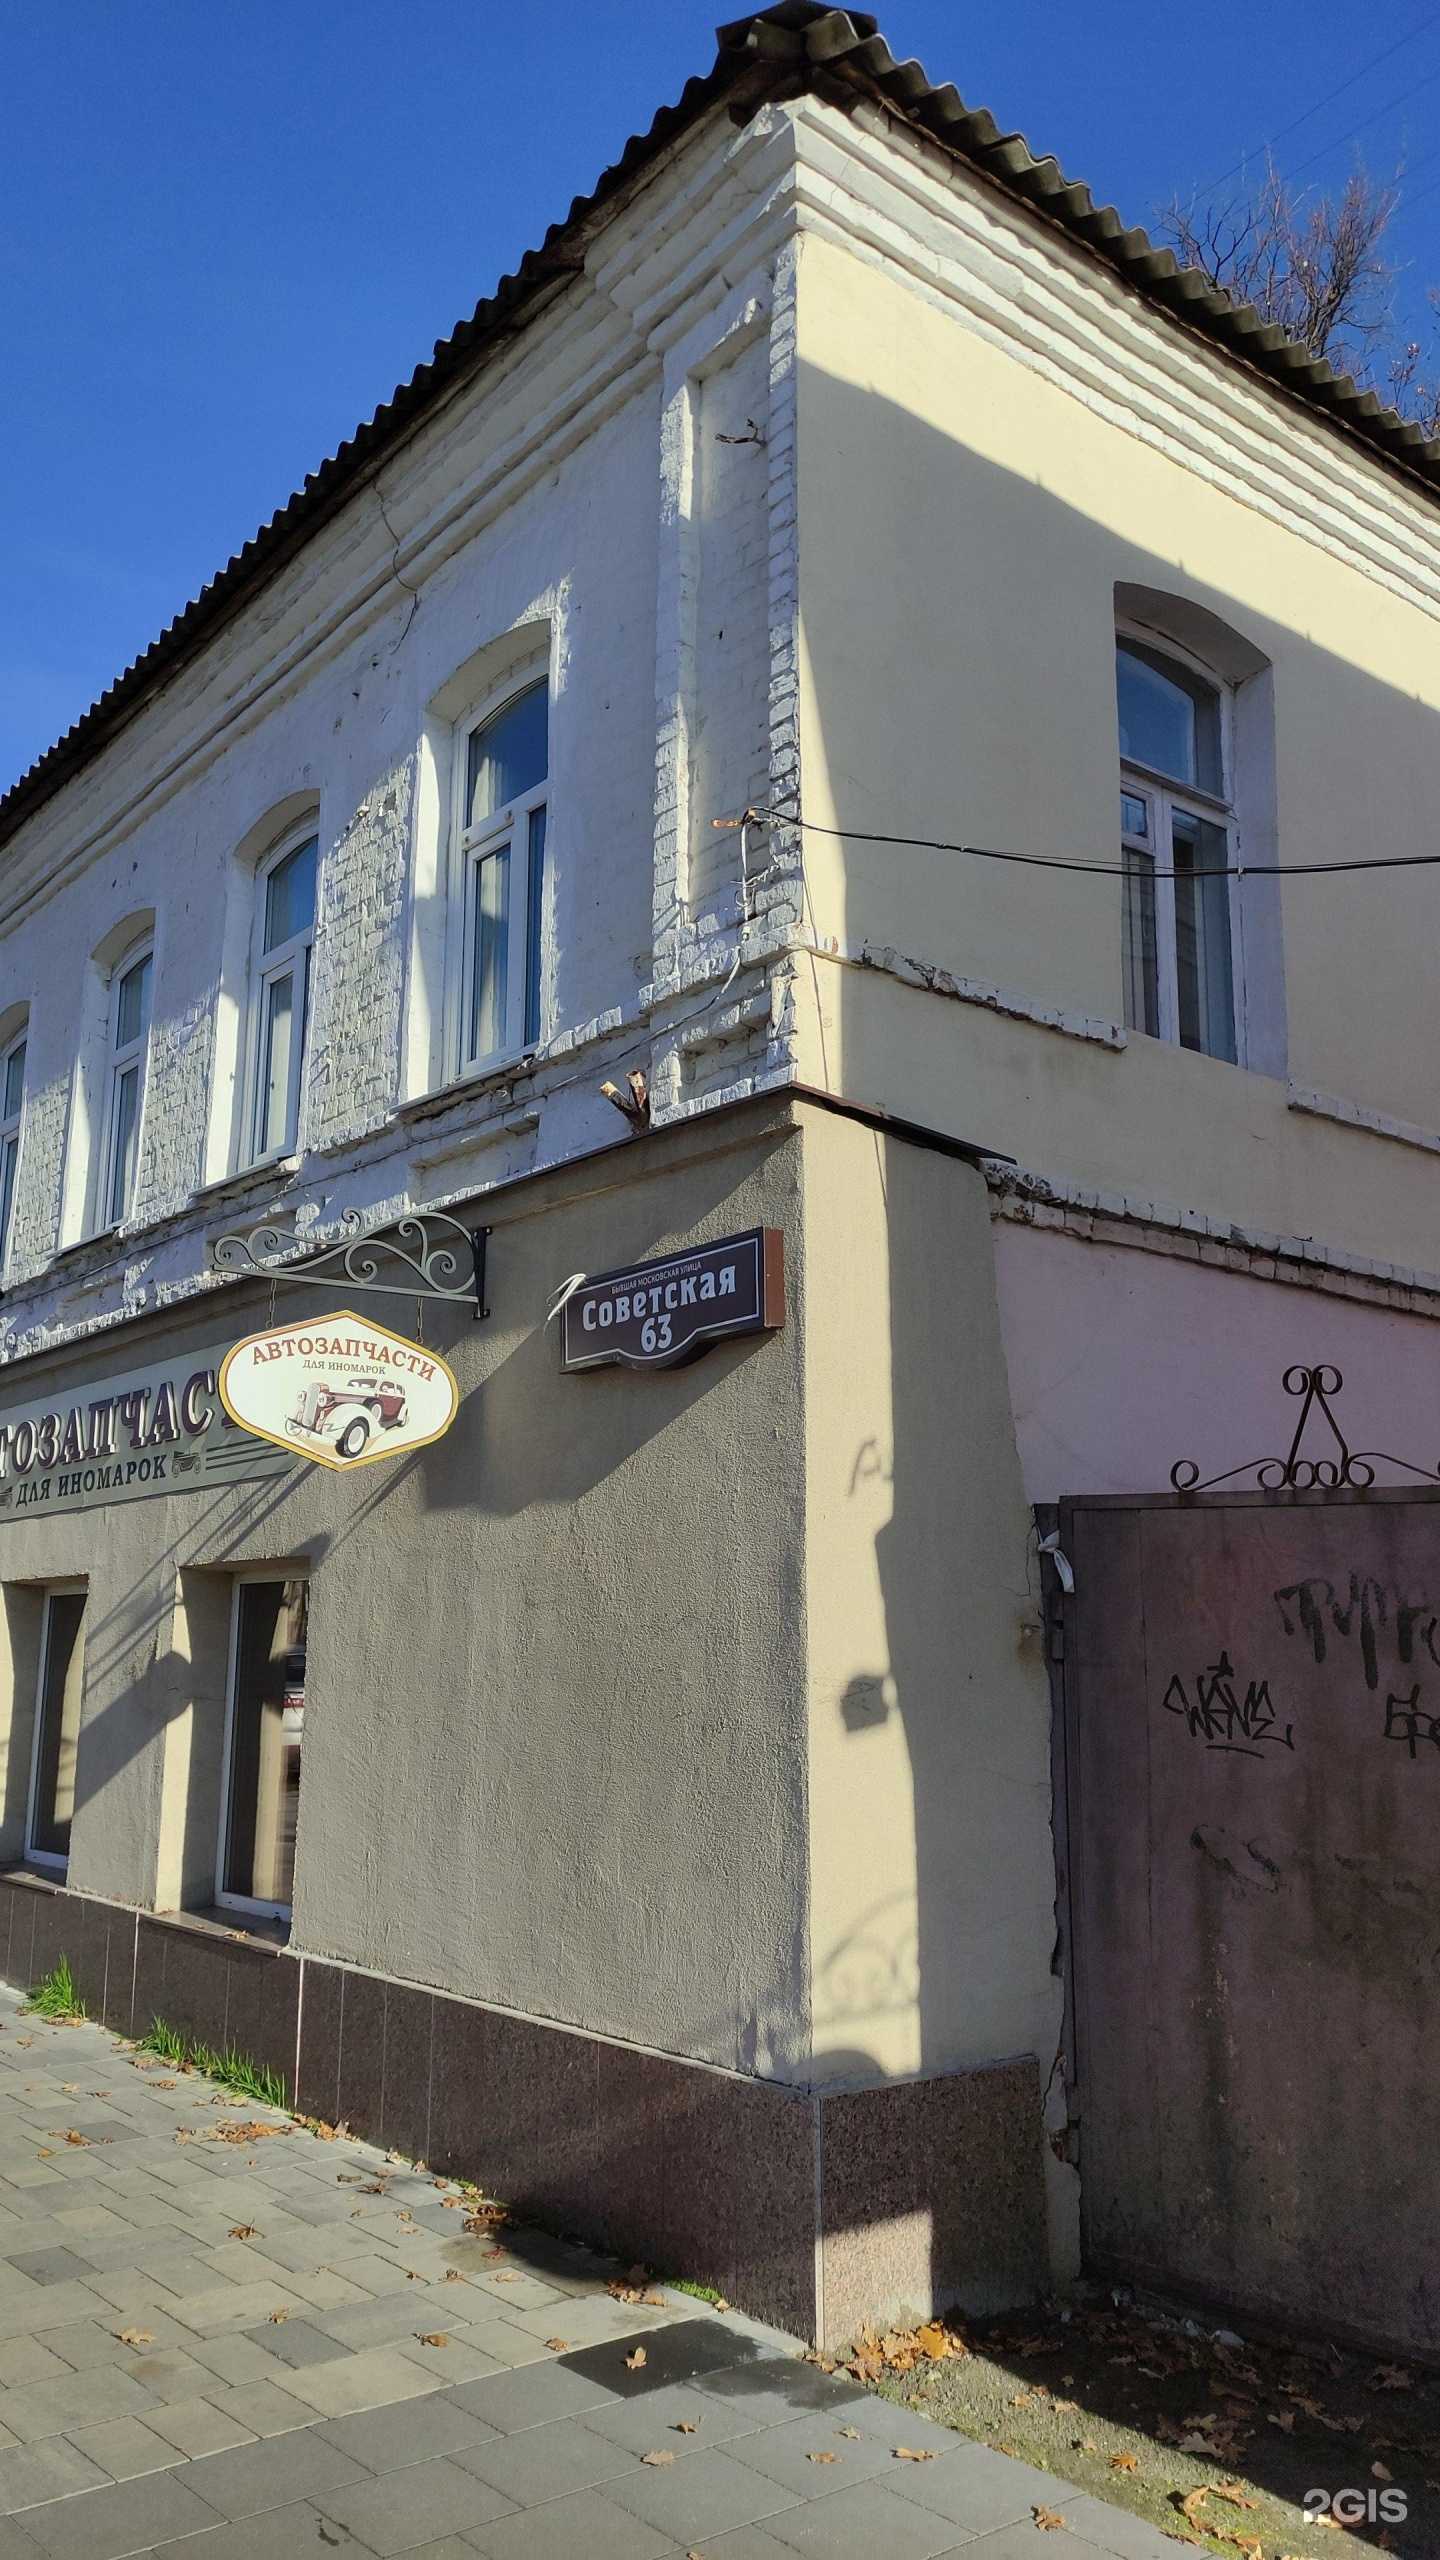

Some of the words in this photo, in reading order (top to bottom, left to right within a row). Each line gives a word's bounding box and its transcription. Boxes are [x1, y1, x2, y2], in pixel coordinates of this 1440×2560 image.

[611, 1278, 638, 1294] БЫВШАЯ
[638, 1267, 680, 1287] МОСКОВСКАЯ
[680, 1261, 702, 1276] УЛИЦА
[640, 1313, 673, 1353] 63
[252, 1337, 438, 1383] АВТОЗАПЧАСТИ
[302, 1359, 326, 1370] ДЛЯ
[327, 1361, 386, 1376] ИНОМАРОК
[15, 1478, 51, 1509] ДЛЯ
[57, 1454, 167, 1498] ИНОМАРОК
